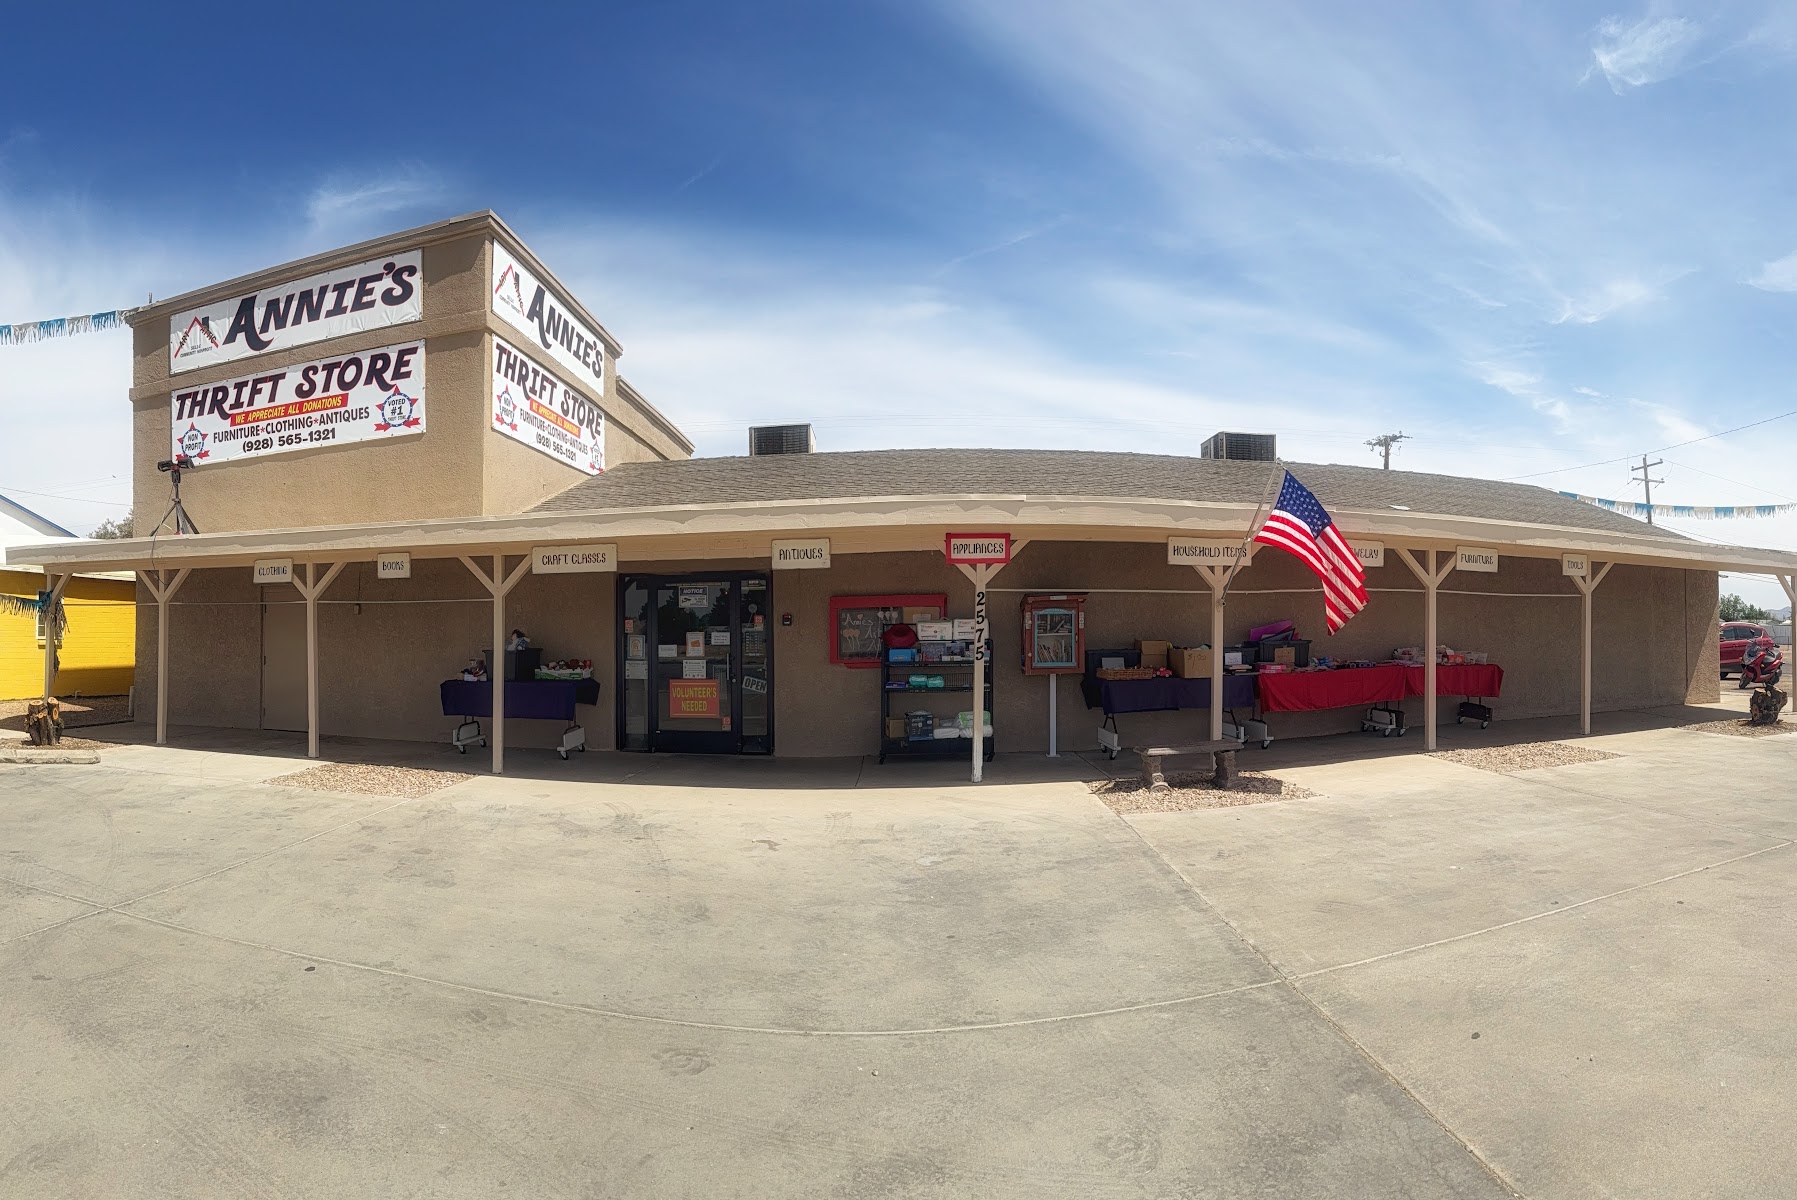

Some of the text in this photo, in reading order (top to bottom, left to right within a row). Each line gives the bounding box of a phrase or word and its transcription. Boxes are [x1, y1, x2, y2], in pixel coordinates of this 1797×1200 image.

[222, 261, 418, 351] ANNIE'S
[526, 283, 603, 379] ANNIE'S
[175, 346, 419, 421] THRIFT STORE
[495, 342, 557, 406] THRIFT
[561, 388, 603, 440] STORE
[235, 395, 343, 424] WE APPRECIATE ALL DONATIONS
[387, 398, 406, 408] VOTED
[391, 405, 403, 416] #1
[213, 406, 370, 444] FURNITURE CLOTHING ANTIQUES
[187, 433, 199, 442] NON
[242, 427, 336, 453] (928) 565-1321
[185, 442, 202, 452] PROFIT
[536, 431, 551, 450] (928)
[552, 440, 577, 463] 565-1321
[779, 547, 823, 560] ANTIQUES
[952, 543, 1004, 554] APPLIANCES
[1173, 545, 1247, 558] HOUSEHOLD ITEMS
[542, 552, 606, 565] CRAFT CLASSES
[1460, 553, 1494, 565] FURNITURE
[1567, 560, 1584, 570] TOOLS
[258, 566, 287, 577] CLOTHING
[382, 560, 405, 571] BOOKS
[744, 677, 767, 693] OPEN
[672, 687, 717, 698] VOLUNTEER'S
[681, 700, 708, 712] NEEDED
